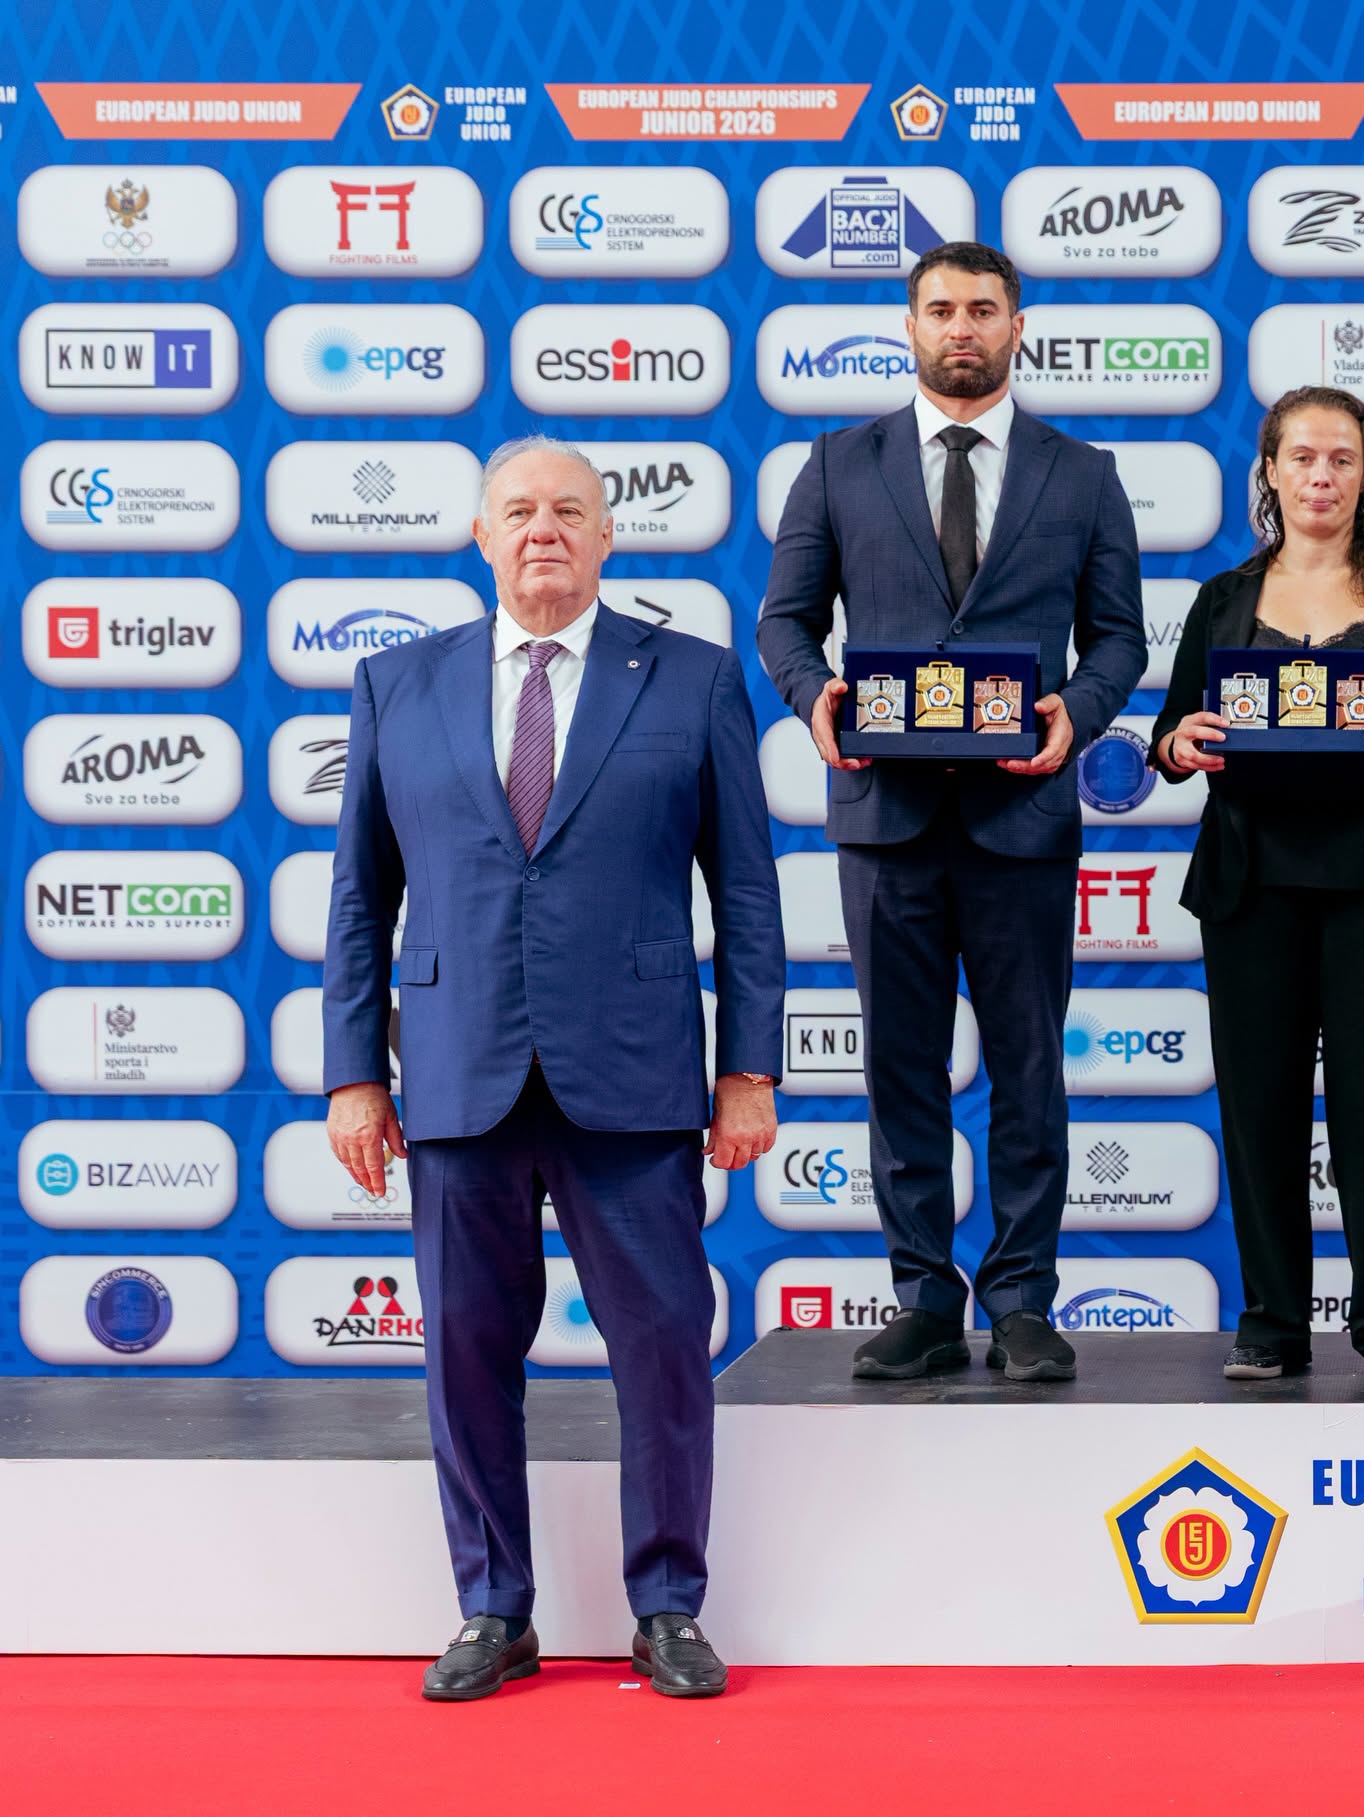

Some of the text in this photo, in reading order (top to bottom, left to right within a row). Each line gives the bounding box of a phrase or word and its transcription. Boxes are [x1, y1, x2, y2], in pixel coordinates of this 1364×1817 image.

[445, 87, 526, 104] EUROPEAN
[578, 89, 837, 109] EUROPEAN JUDO CHAMPIONSHIPS
[954, 87, 1036, 104] EUROPEAN
[96, 101, 302, 122] EUROPEAN JUDO UNION
[466, 106, 506, 122] JUDO
[975, 106, 1015, 123] JUDO
[1114, 101, 1321, 122] EUROPEAN JUDO UNION
[640, 111, 775, 134] JUNIOR 2026
[460, 124, 511, 140] UNION
[970, 124, 1020, 141] UNION
[606, 214, 674, 224] CRNOGORSKI
[834, 209, 898, 230] BACK
[1039, 187, 1184, 236] AROMA
[606, 228, 704, 238] ELEKTROPRENOSNI
[834, 230, 898, 245] NUMBER
[606, 241, 644, 250] SISTEM
[1064, 246, 1159, 257] Sve za tebe
[330, 255, 418, 264] FIGHTING FILMS
[861, 250, 895, 263] .com
[59, 344, 197, 371] KNOW IT
[364, 346, 446, 380] epcg
[537, 338, 705, 381] essimo
[781, 344, 919, 380] Montepu
[1016, 374, 1209, 382] SOFTWARE AND SUPPORT
[1334, 373, 1362, 385] Crne
[607, 462, 694, 507] OMA
[117, 488, 185, 498] CRNOGORSKI
[117, 502, 215, 511] ELEKTROPRENOSNI
[117, 515, 154, 524] SISTEM
[312, 514, 438, 525] MILLENNIUM
[631, 520, 668, 532] tebe
[109, 617, 215, 656] triglav
[61, 735, 205, 784] AROMA
[85, 793, 180, 804] Sve za tebe
[38, 920, 231, 928] SOFTWARE AND SUPPORT
[1126, 940, 1158, 949] FILMS
[105, 1042, 177, 1053] Ministarstvo
[800, 1029, 857, 1054] KNO
[1103, 1030, 1186, 1063] epcg
[105, 1057, 140, 1068] sporta
[105, 1069, 145, 1080] mladih
[87, 1163, 220, 1187] BIZAWAY
[91, 1267, 168, 1300] SINCOMMERCE
[1062, 1300, 1175, 1332] onteput
